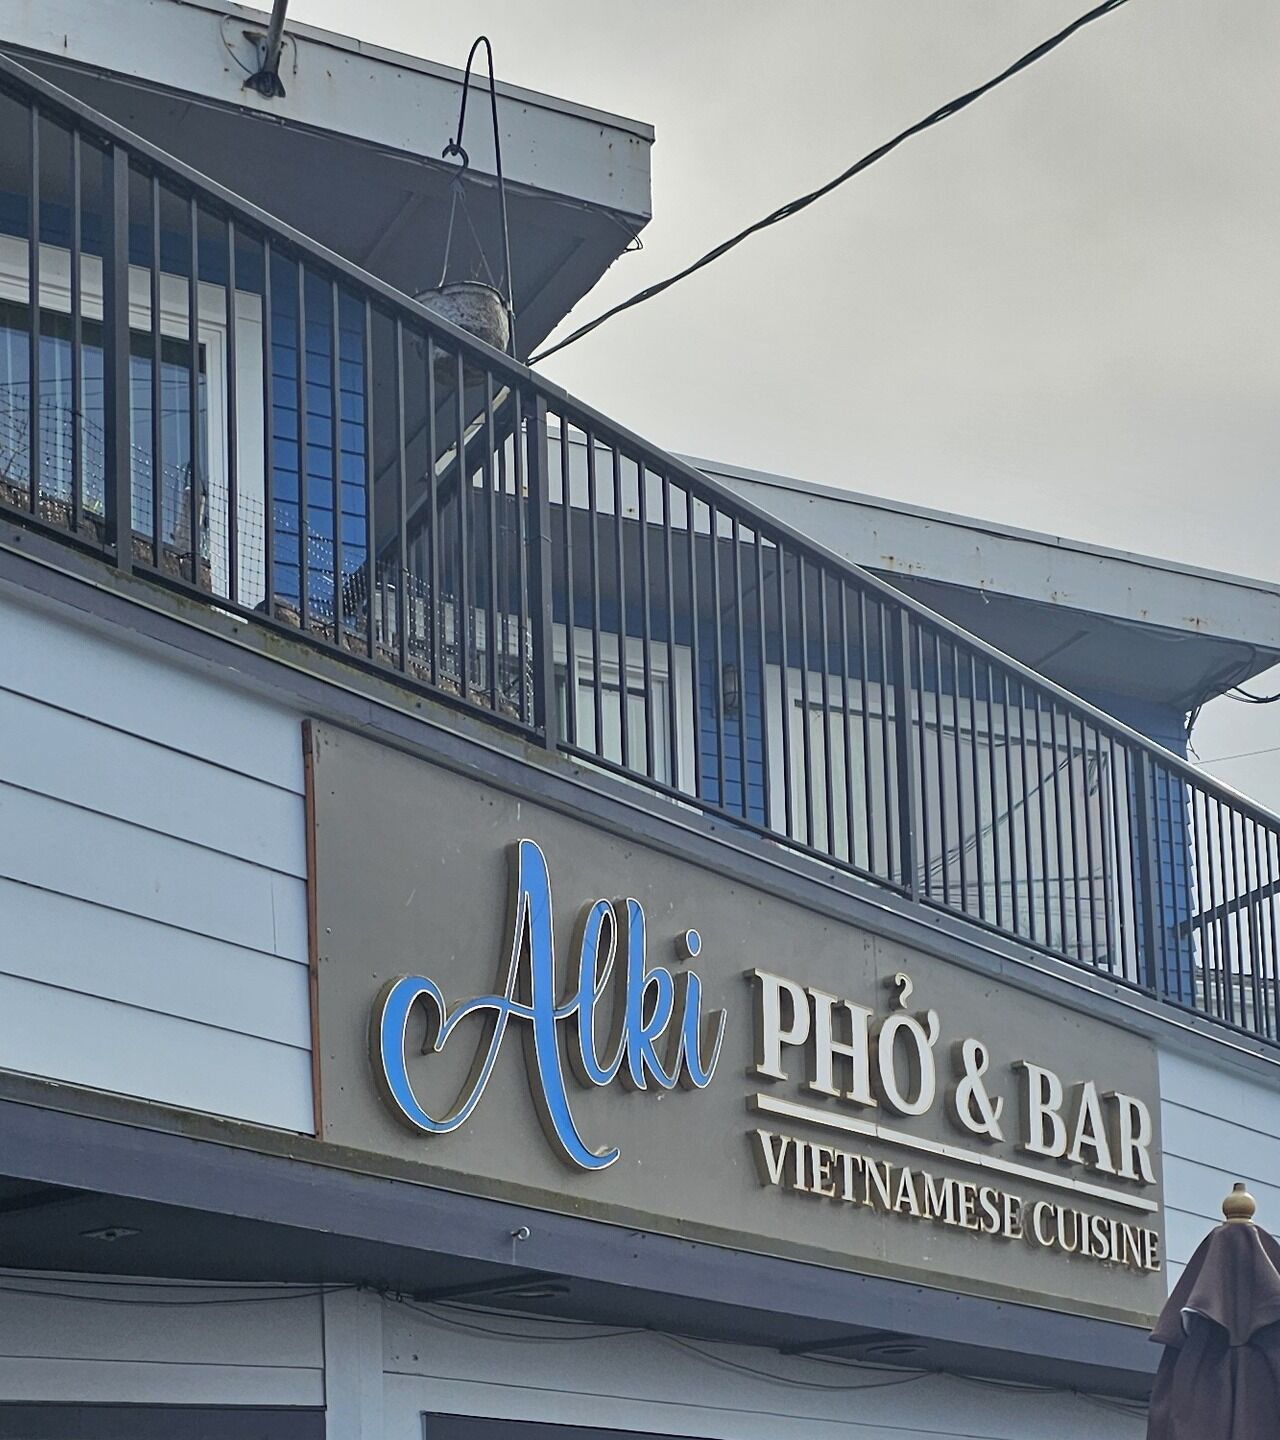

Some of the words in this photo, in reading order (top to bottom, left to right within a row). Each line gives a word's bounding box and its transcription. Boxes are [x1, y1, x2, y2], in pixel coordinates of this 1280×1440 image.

[378, 838, 727, 1172] Alki
[747, 967, 940, 1117] PHỞ
[953, 1037, 1006, 1142] &
[1015, 1059, 1157, 1184] BAR
[752, 1129, 1024, 1239] VIETNAMESE
[1030, 1200, 1161, 1272] CUISINE
